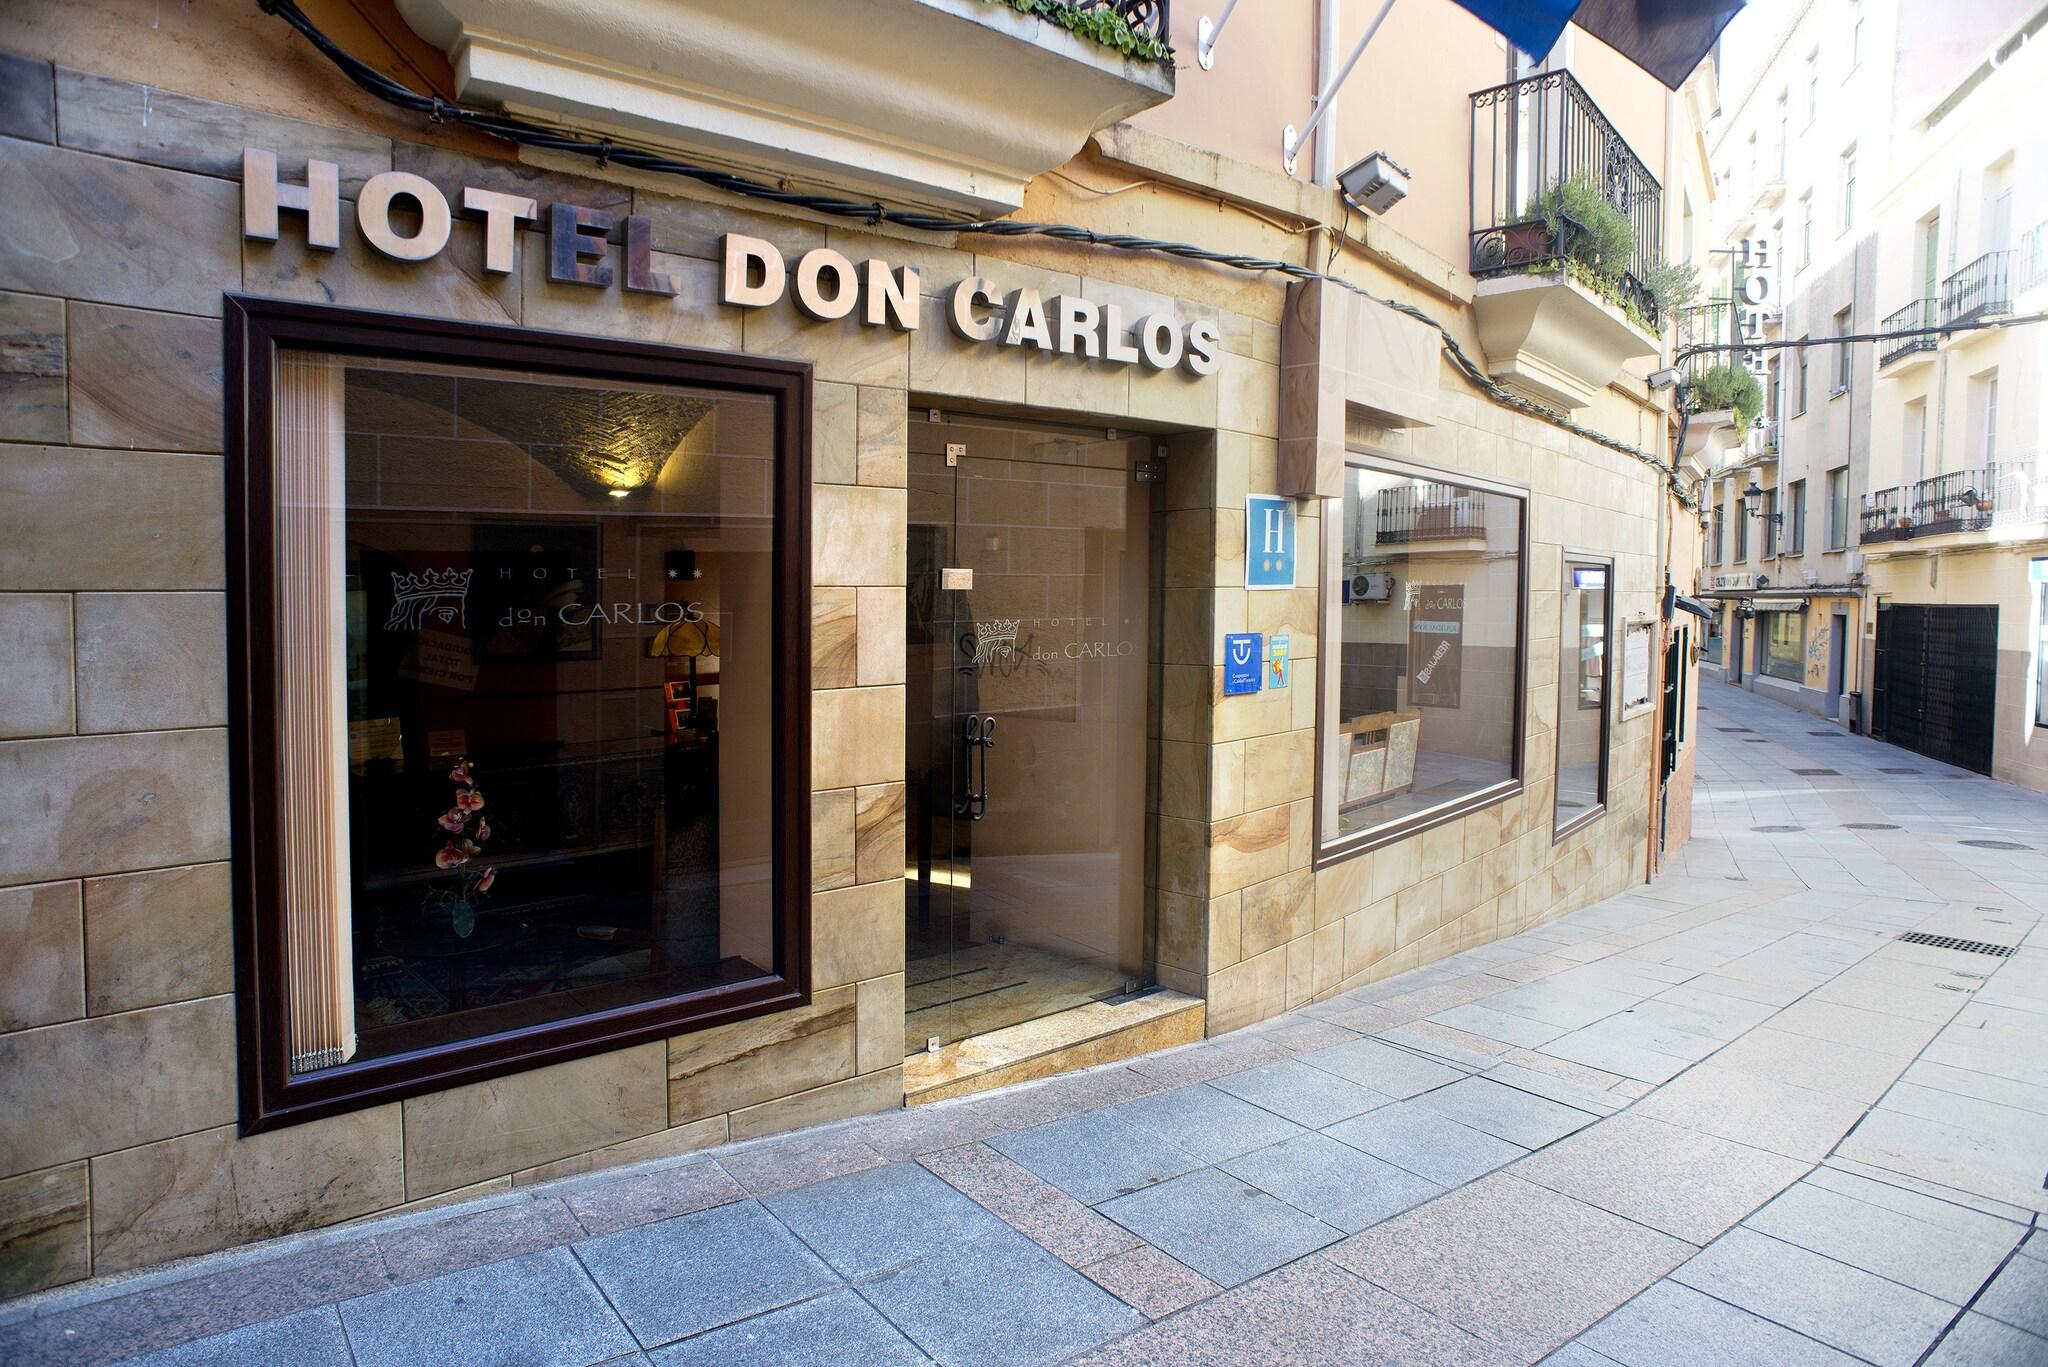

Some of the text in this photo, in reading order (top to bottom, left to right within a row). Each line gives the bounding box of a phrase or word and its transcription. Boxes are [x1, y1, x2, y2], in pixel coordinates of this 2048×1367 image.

[242, 145, 1221, 377] HOTEL DON CARLOS
[1262, 508, 1286, 554] H
[499, 567, 638, 580] HOTEL
[499, 601, 705, 628] don CARLOS
[1032, 618, 1110, 628] HOTEL
[1032, 645, 1059, 661] don
